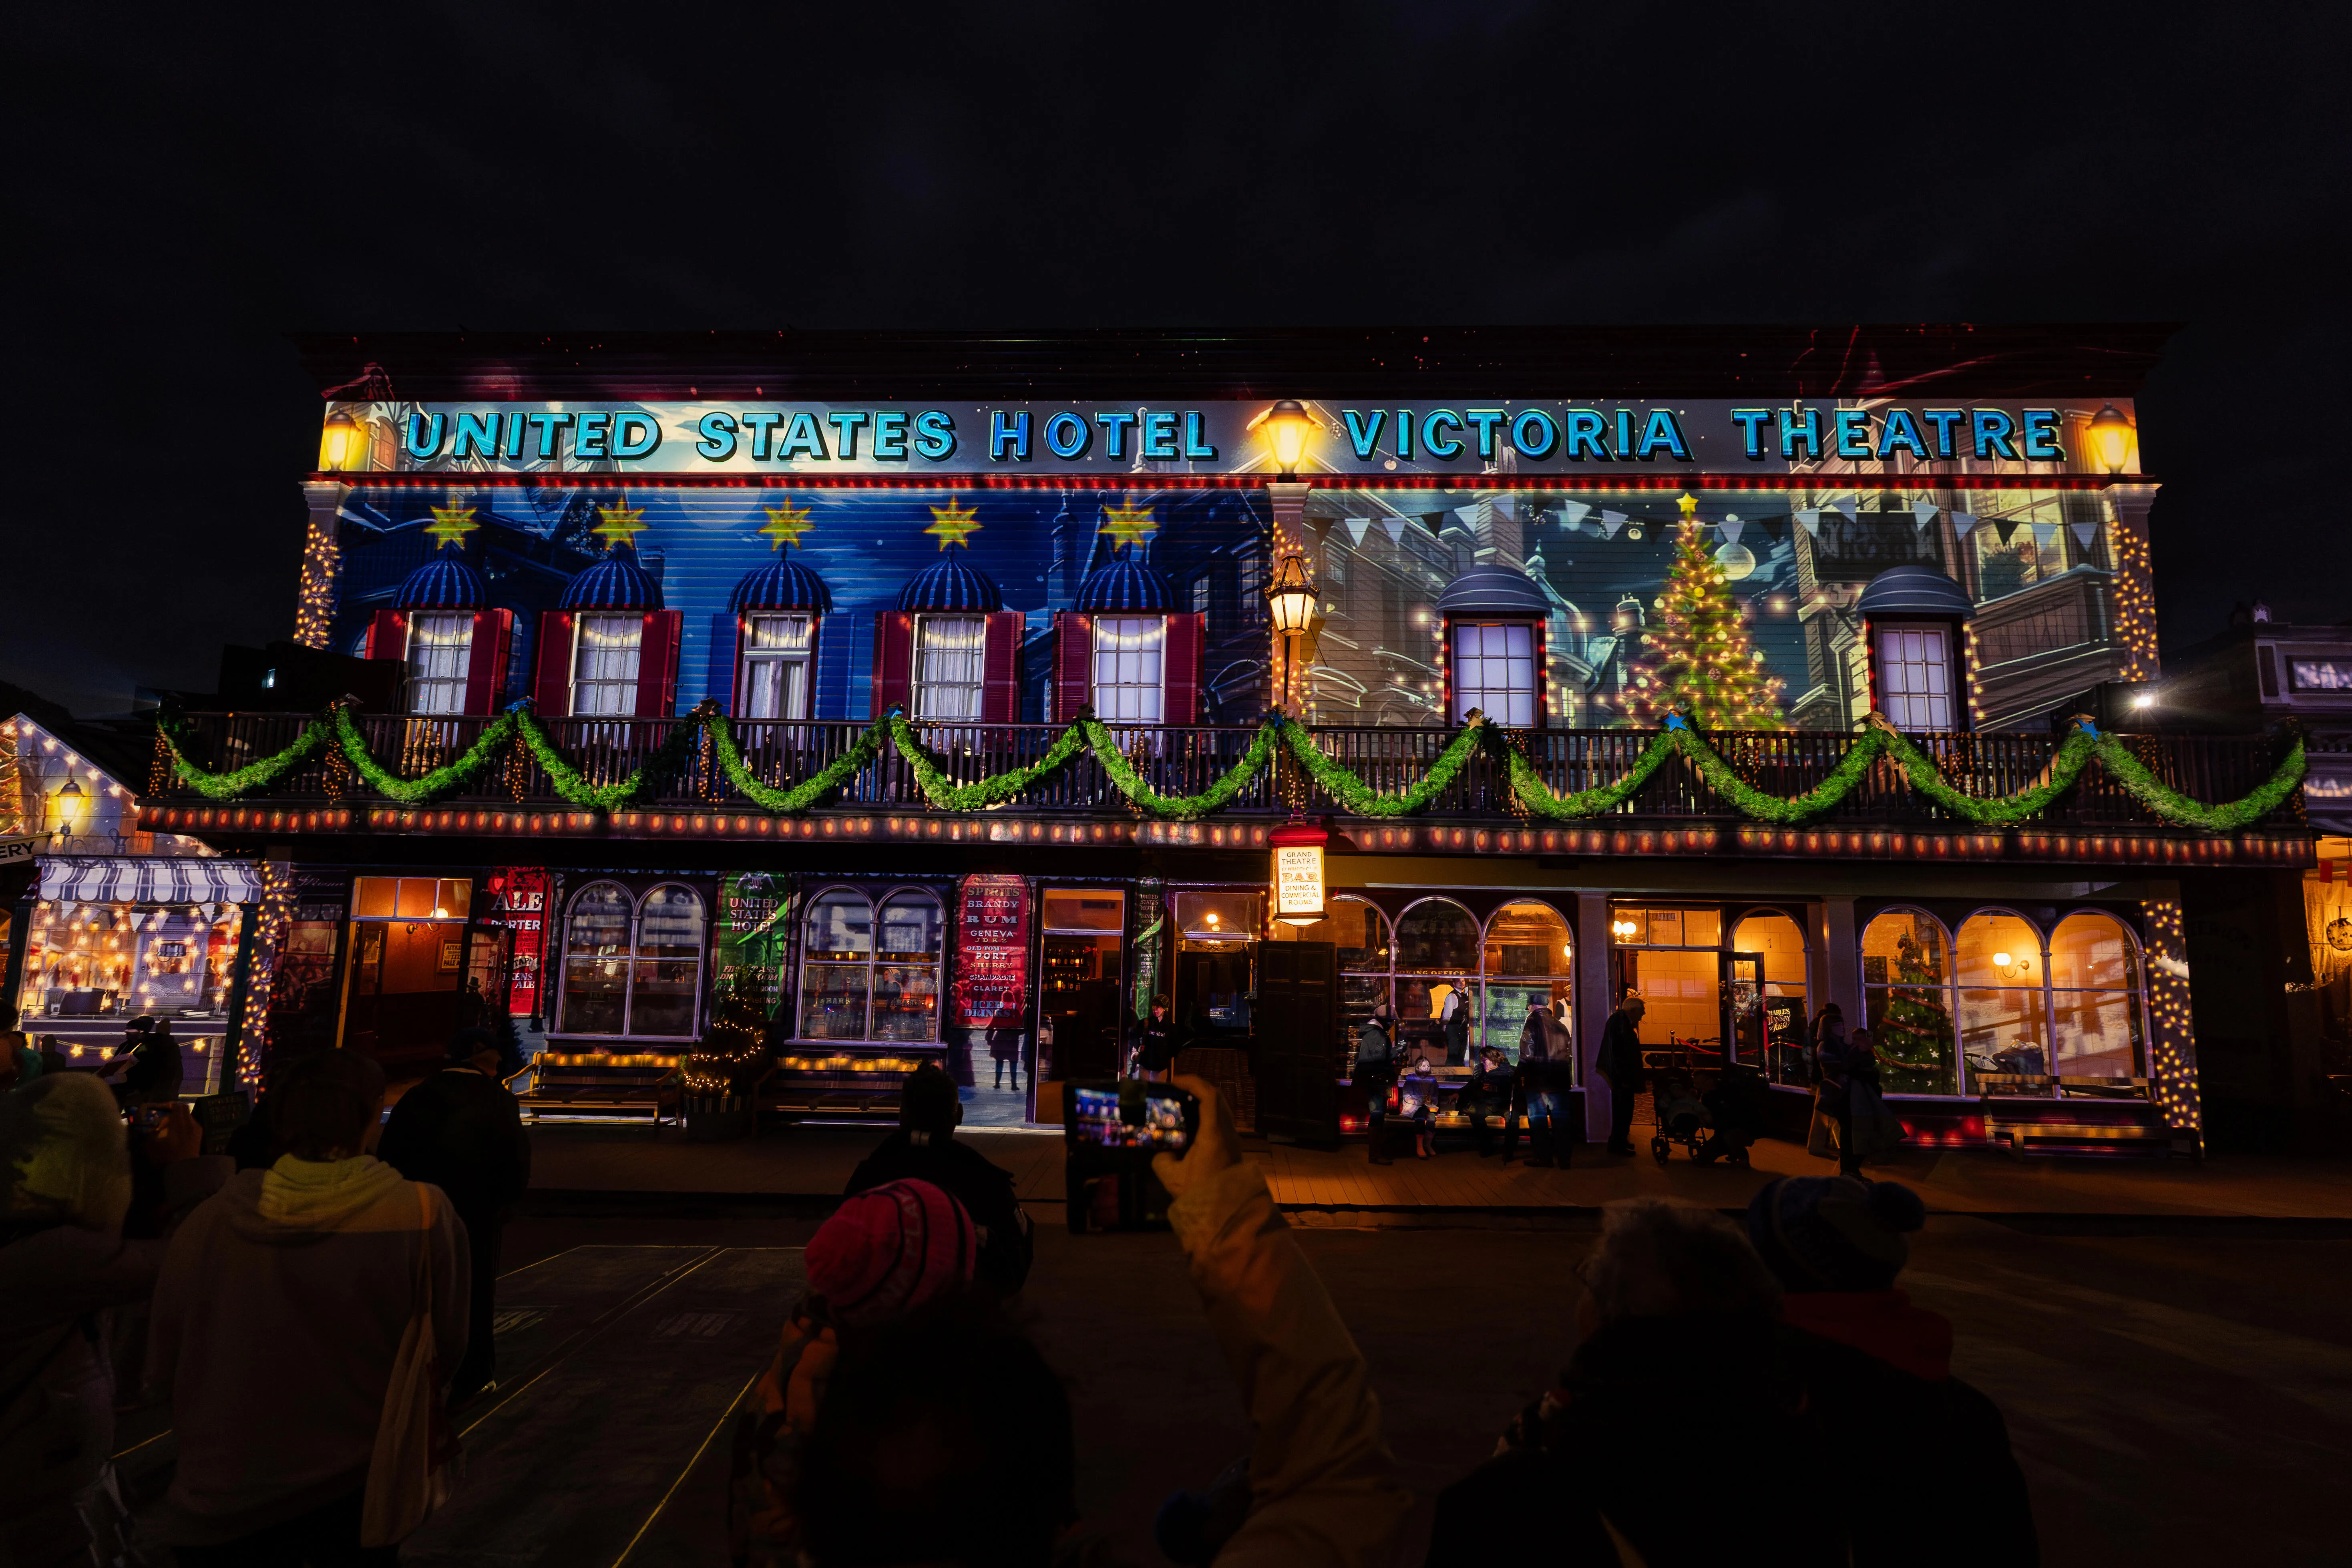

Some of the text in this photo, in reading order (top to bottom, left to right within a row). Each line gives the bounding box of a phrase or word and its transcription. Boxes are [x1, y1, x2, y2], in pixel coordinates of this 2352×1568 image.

[406, 410, 1219, 462] UNITED STATES HOTEL
[1342, 408, 2067, 461] VICTORIA THEATRE
[1282, 872, 1319, 883] BAR
[967, 887, 1020, 897] SPIRITS
[491, 892, 543, 911] ALE
[730, 898, 778, 908] UNITED
[730, 909, 777, 920] STATES
[732, 921, 774, 931] HOTEL
